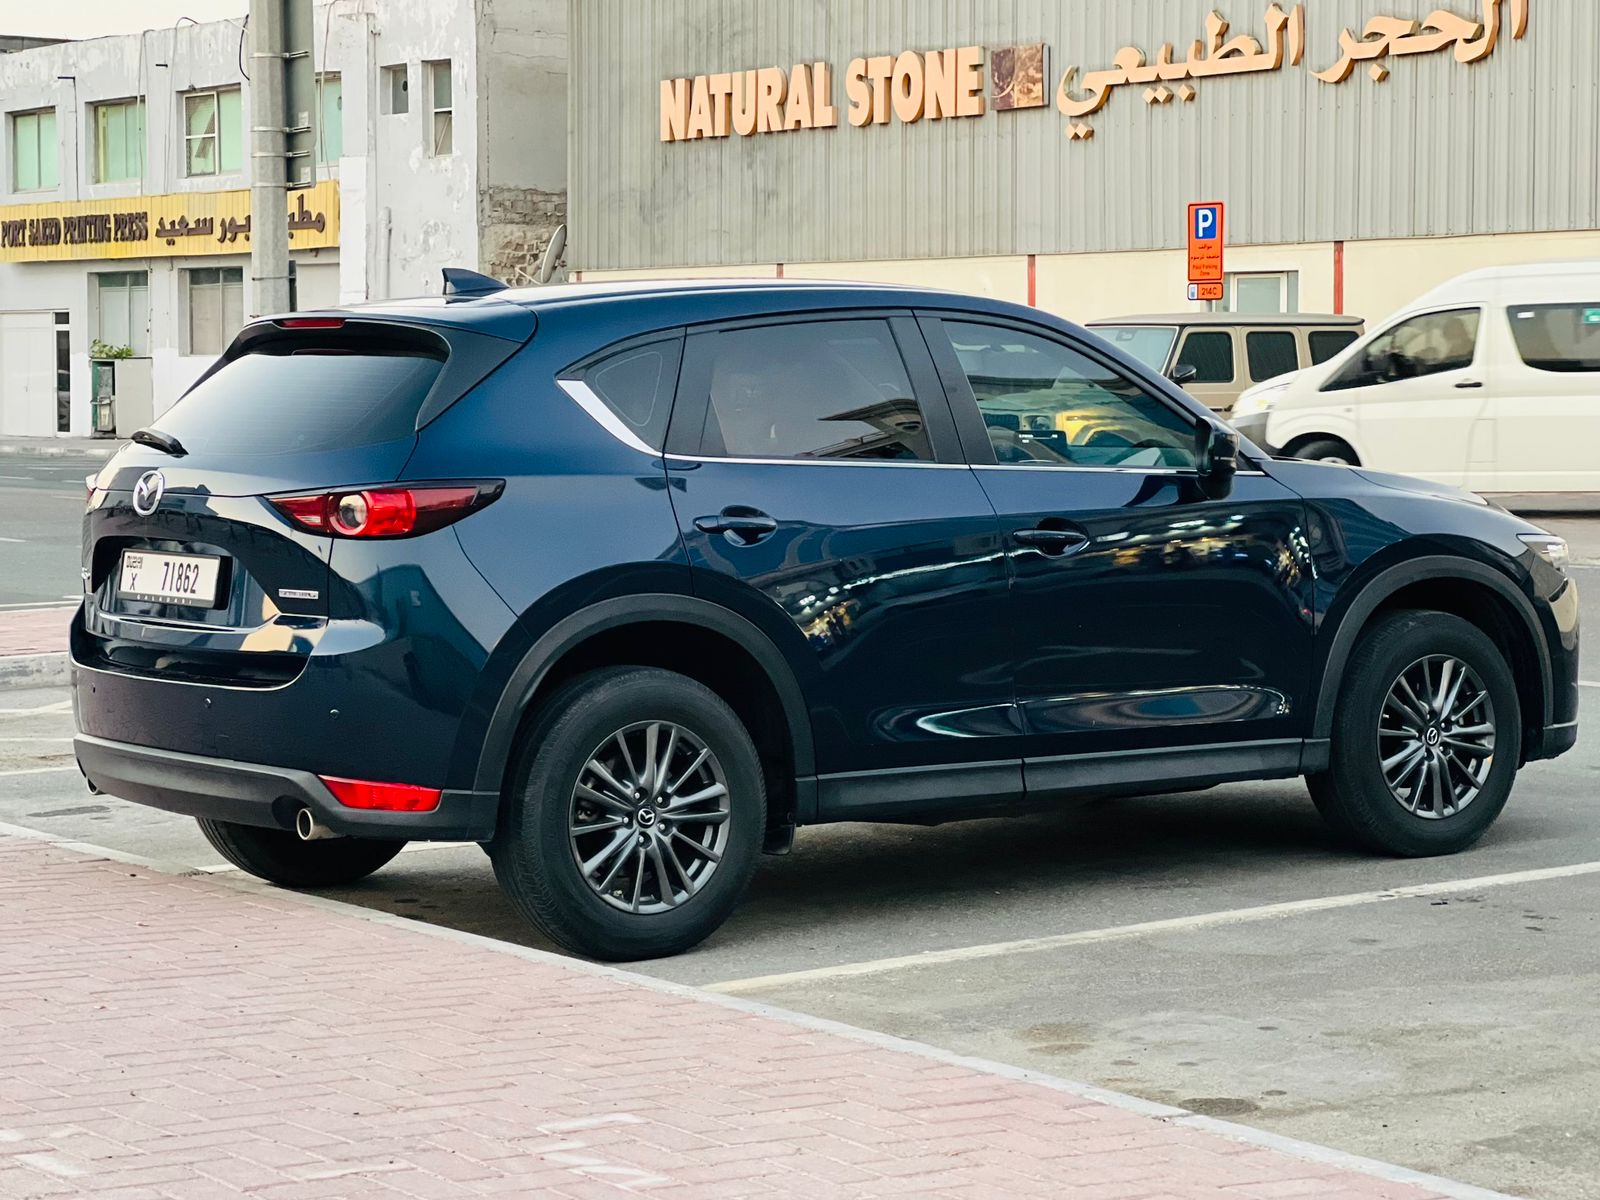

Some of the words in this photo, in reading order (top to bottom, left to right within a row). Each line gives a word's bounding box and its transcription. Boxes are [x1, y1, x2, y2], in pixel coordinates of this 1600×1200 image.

[1056, 2, 1306, 141] الطبيعي
[660, 62, 837, 142] NATURAL
[845, 46, 984, 127] STONE
[1, 219, 27, 248] PORT
[28, 217, 61, 247] SAEED
[63, 213, 112, 245] PRINTING
[113, 211, 149, 243] PRESS
[155, 215, 214, 246] سعيد
[1198, 209, 1213, 238] P
[129, 572, 138, 591] X
[161, 561, 200, 594] 71862
